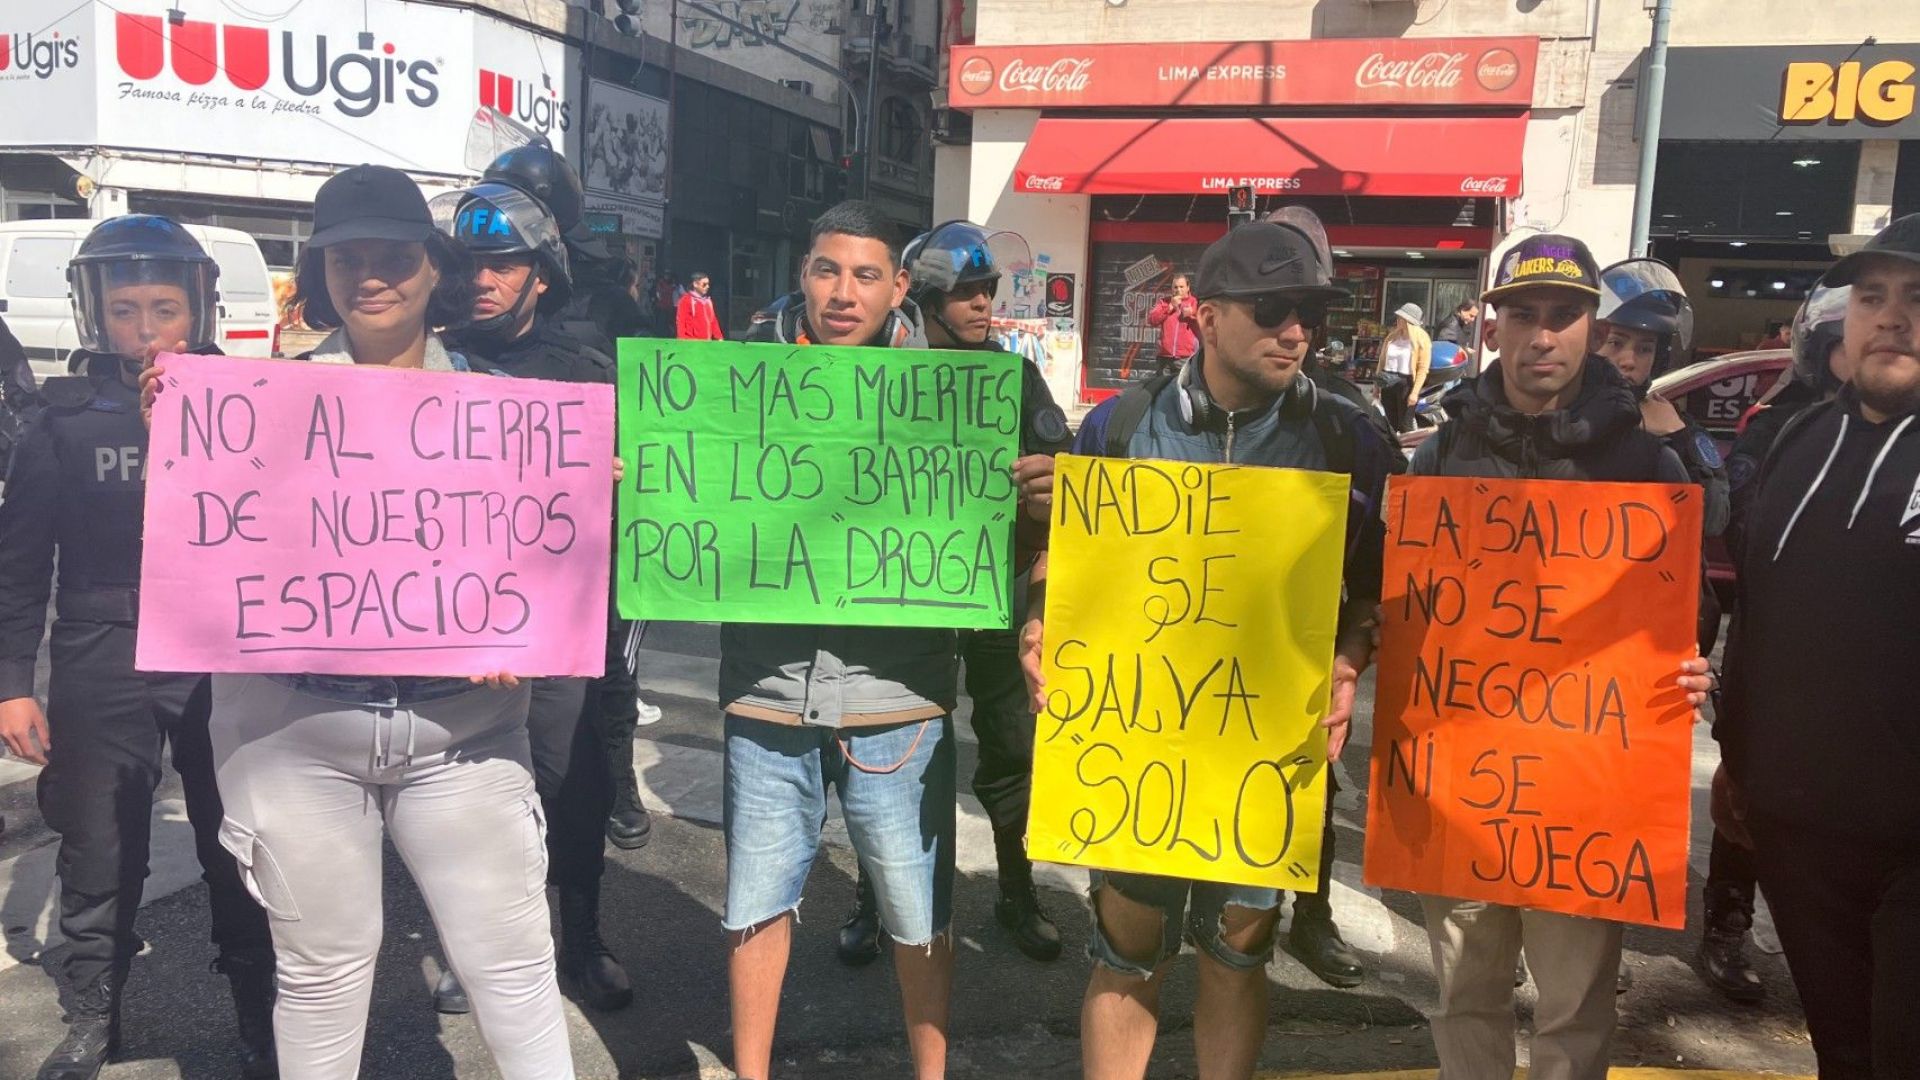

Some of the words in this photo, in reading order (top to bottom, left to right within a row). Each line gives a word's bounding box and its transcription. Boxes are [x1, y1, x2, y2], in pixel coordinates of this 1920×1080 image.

[14, 31, 79, 79] Ugi's
[282, 31, 439, 117] Ugi's
[1158, 66, 1200, 80] LIMA
[1206, 65, 1286, 80] EXPRESS
[1782, 60, 1916, 121] BIG
[118, 82, 181, 101] Famosa
[187, 92, 228, 110] pizza
[235, 99, 244, 108] a
[251, 96, 267, 109] la
[272, 99, 320, 114] piedra
[518, 80, 570, 135] Ugi's
[1202, 178, 1234, 188] LIMA
[1239, 178, 1301, 189] EXPRESS
[1514, 257, 1555, 278] LAKERS
[304, 393, 374, 478] AL
[410, 392, 590, 482] CIERRE
[855, 363, 1016, 446] MUERTES
[95, 446, 147, 482] PF
[636, 431, 697, 503] EN
[730, 442, 824, 502] LOS
[845, 444, 1014, 520] BARRIOS
[1060, 459, 1240, 536] NADIE
[187, 490, 268, 546] DE
[312, 488, 576, 560] NUESTROS
[625, 518, 720, 601] POR
[750, 522, 821, 604] LA
[1397, 490, 1462, 559] LA
[235, 560, 530, 638] ESPACIOS
[1144, 554, 1236, 643] SE
[1404, 568, 1466, 626] NO
[1485, 579, 1566, 645] SE
[1045, 640, 1260, 742] SALVA
[1414, 646, 1629, 750] NEGOCIA
[1387, 731, 1434, 799] NI
[1459, 748, 1543, 816] SE
[1471, 818, 1660, 921] JUEGA
